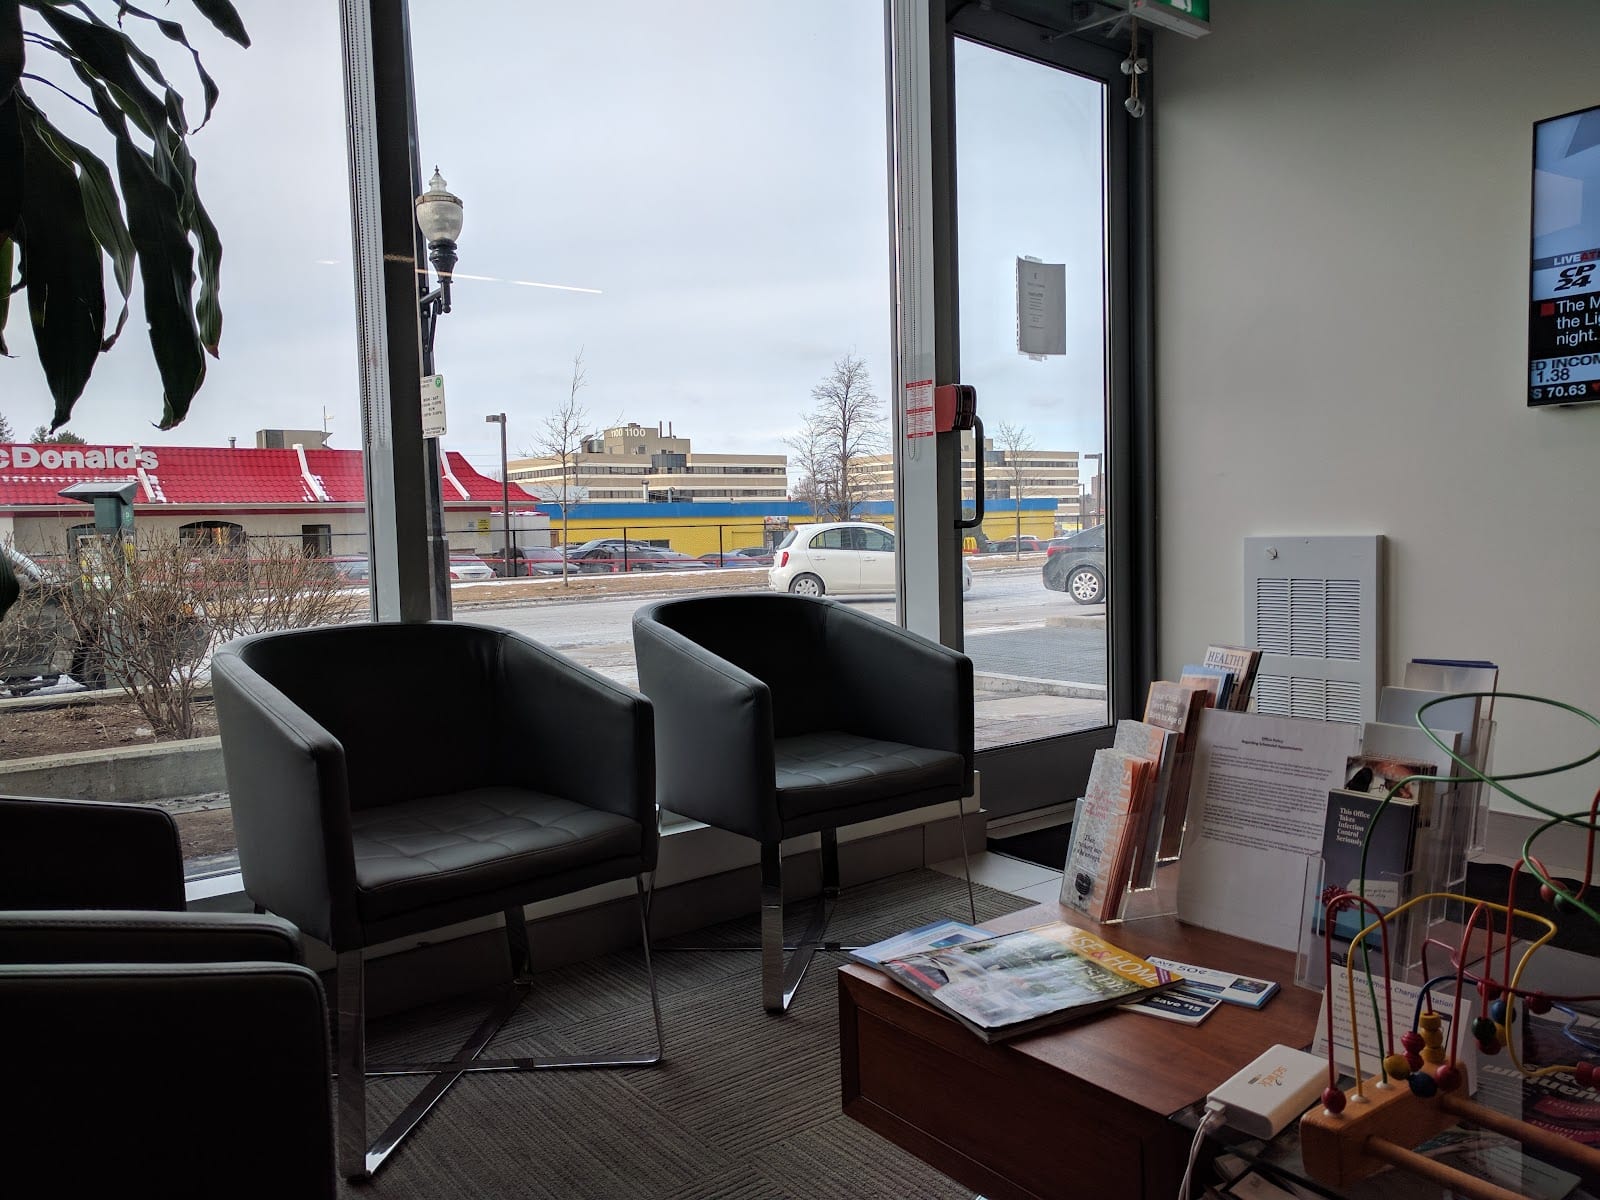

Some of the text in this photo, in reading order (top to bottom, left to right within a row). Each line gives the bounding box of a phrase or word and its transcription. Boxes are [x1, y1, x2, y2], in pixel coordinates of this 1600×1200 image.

[1553, 253, 1581, 266] LIVE
[1556, 299, 1585, 314] The
[1557, 311, 1600, 330] the Li
[1556, 328, 1598, 347] night.
[1536, 367, 1570, 383] 1.38
[1547, 383, 1587, 398] 70.63
[625, 428, 646, 437] 1100
[1207, 650, 1248, 668] HEALTHY
[1339, 807, 1371, 820] This Office
[1339, 814, 1356, 823] Takes
[1336, 828, 1360, 838] Control
[1337, 821, 1365, 832] Infection
[1107, 953, 1159, 985] HOME
[1153, 996, 1181, 1008] Save
